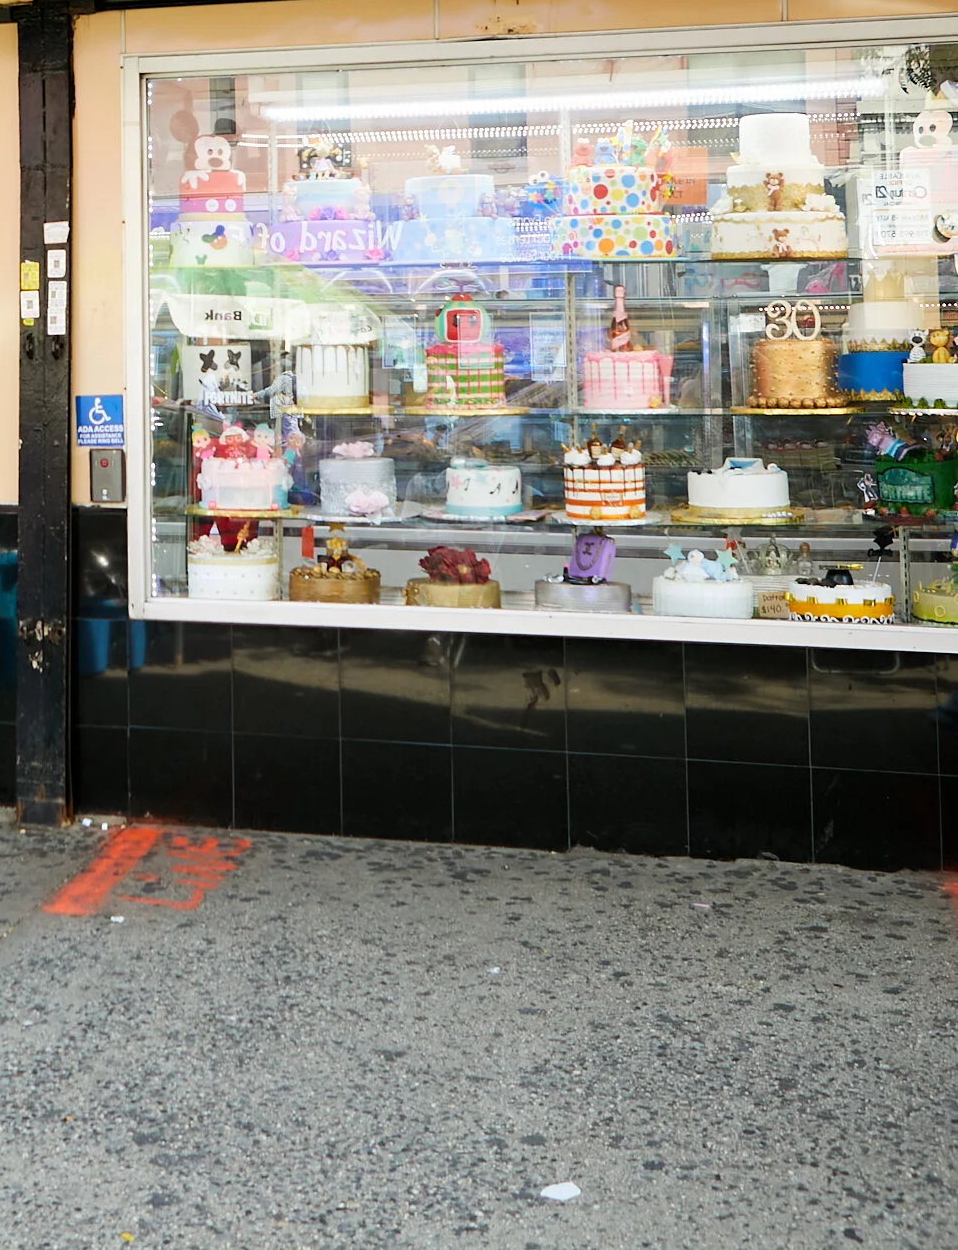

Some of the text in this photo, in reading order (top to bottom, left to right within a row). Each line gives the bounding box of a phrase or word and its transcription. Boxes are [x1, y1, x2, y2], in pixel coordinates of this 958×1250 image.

[765, 300, 821, 340] 30
[78, 424, 123, 433] ADA ACCESS
